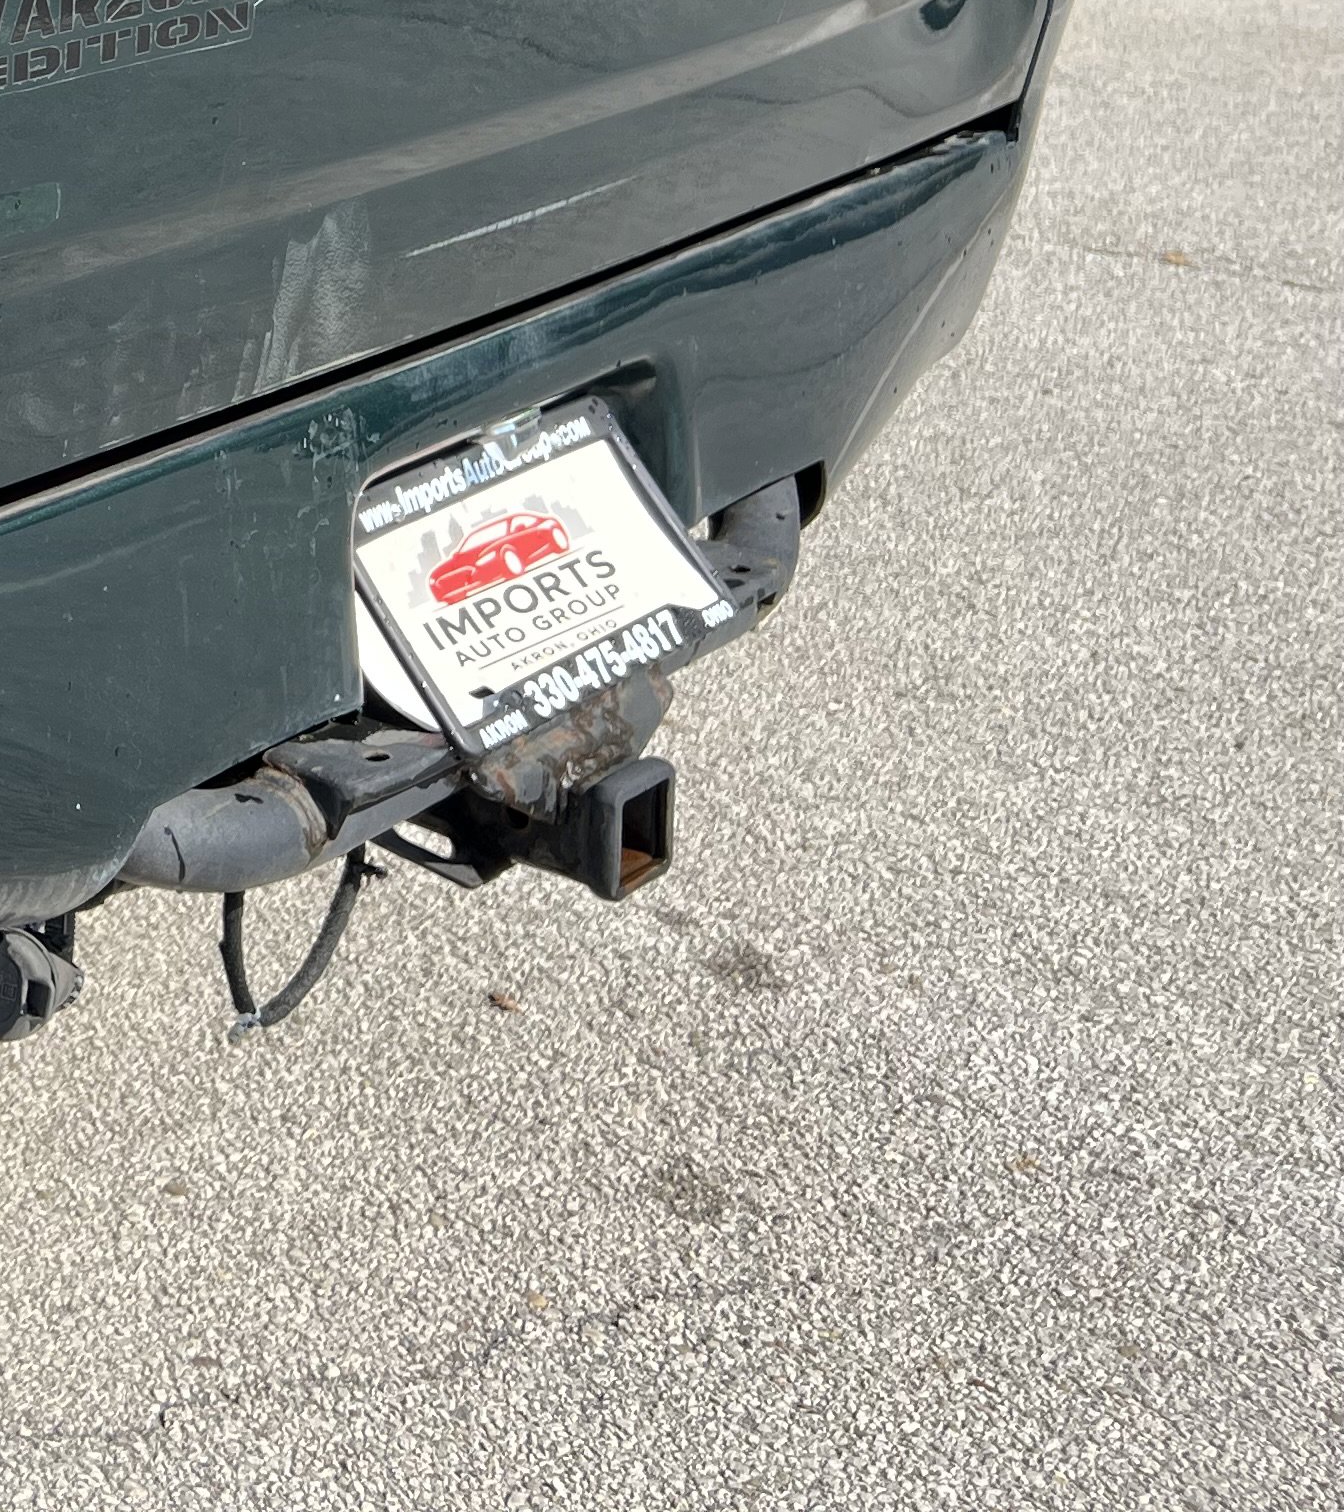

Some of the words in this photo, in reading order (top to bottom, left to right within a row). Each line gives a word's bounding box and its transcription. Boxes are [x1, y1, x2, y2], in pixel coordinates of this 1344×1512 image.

[423, 549, 617, 651] IMPORTS
[455, 626, 527, 667] AUTO
[532, 583, 621, 631] GROUP
[576, 618, 618, 642] OHIO
[478, 708, 529, 750] AKRON
[523, 608, 684, 718] 330-475-4817
